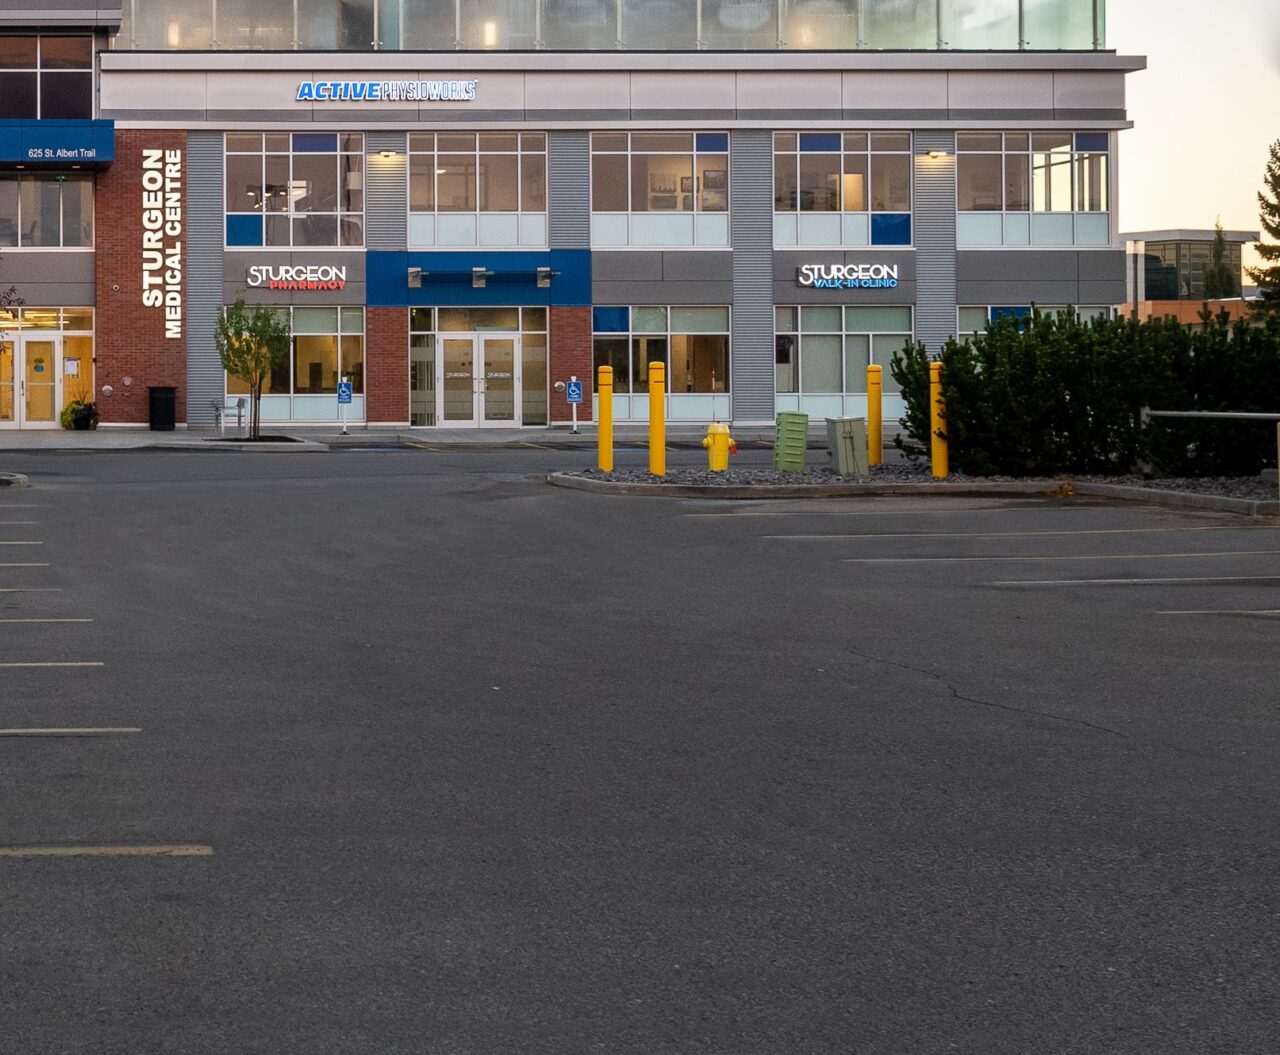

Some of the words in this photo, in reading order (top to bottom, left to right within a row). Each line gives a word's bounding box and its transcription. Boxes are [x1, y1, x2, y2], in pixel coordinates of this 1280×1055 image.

[28, 148, 43, 158] 625
[44, 148, 55, 157] St.
[56, 148, 78, 157] Albert
[79, 148, 96, 157] Trail
[165, 149, 182, 236] CENTRE
[142, 149, 163, 307] STURGEON
[247, 265, 346, 286] STURGEON
[269, 280, 345, 289] PHARMACY
[799, 264, 898, 285] STURGEON
[861, 279, 898, 288] CLINIC
[165, 241, 182, 339] MEDICAL
